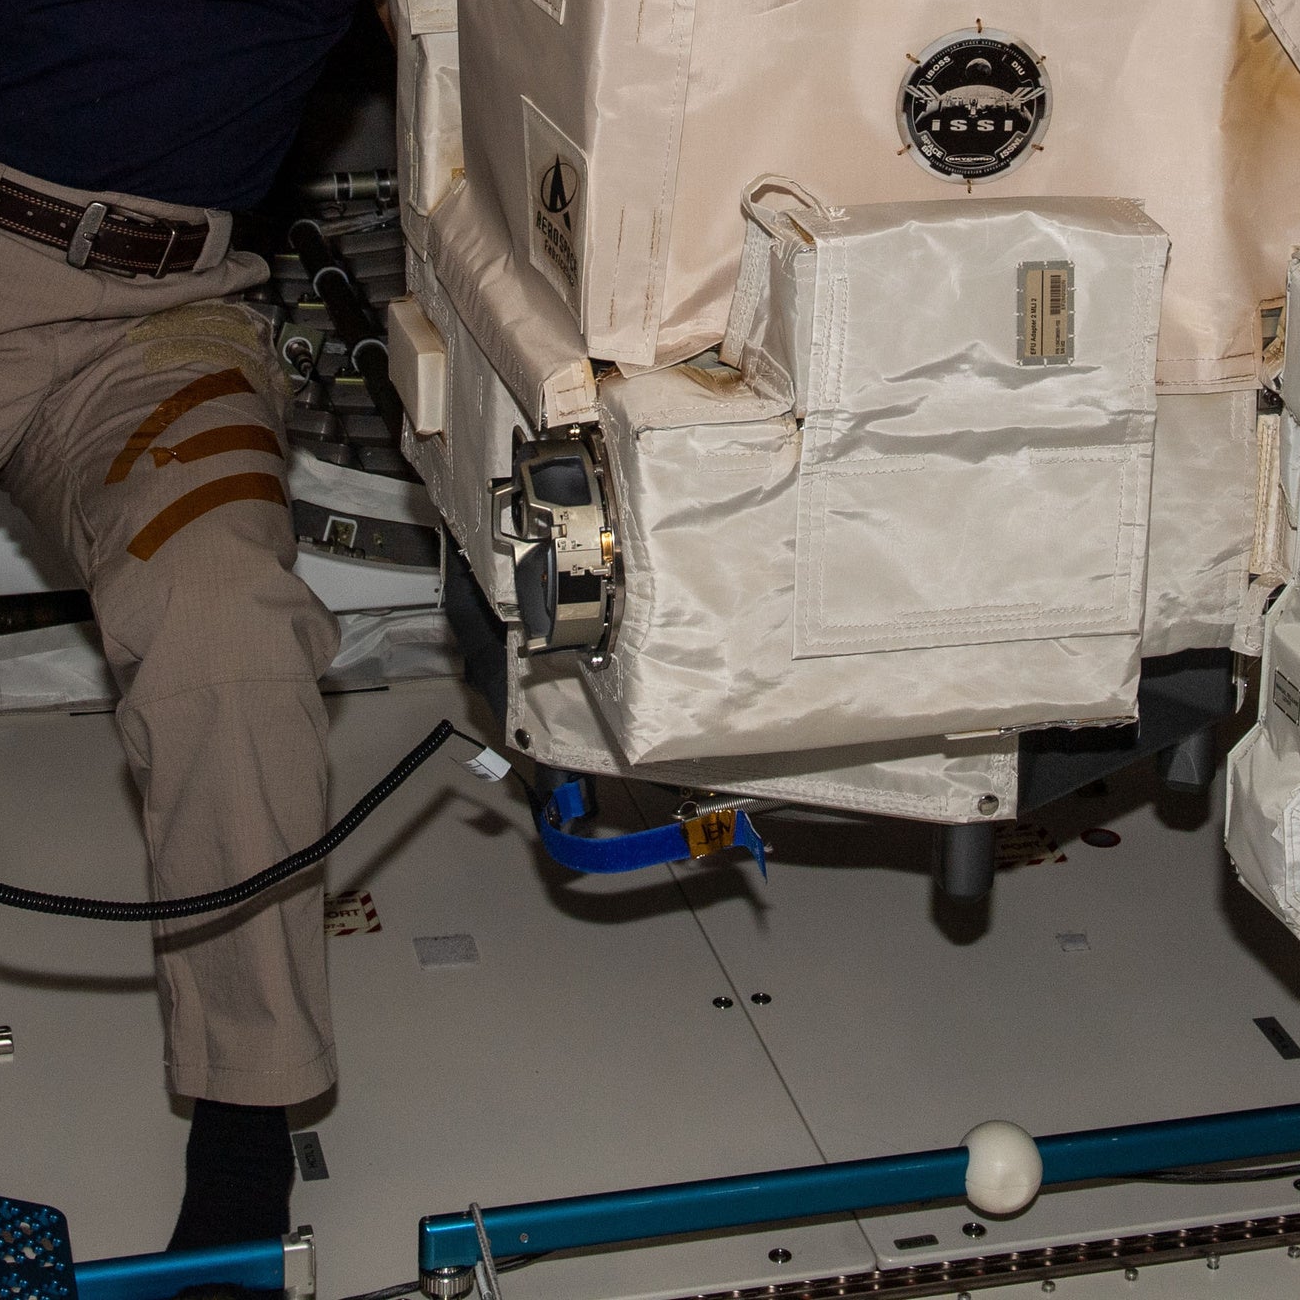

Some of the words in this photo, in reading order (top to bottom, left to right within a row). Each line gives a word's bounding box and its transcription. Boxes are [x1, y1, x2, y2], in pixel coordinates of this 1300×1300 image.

[1011, 61, 1026, 77] DIU
[920, 134, 945, 159] SPACE
[1000, 136, 1025, 159] ISSNL
[535, 209, 579, 278] AEROSPACE
[1029, 319, 1037, 342] Adapter
[1029, 343, 1037, 355] EFU
[326, 908, 360, 919] ORT
